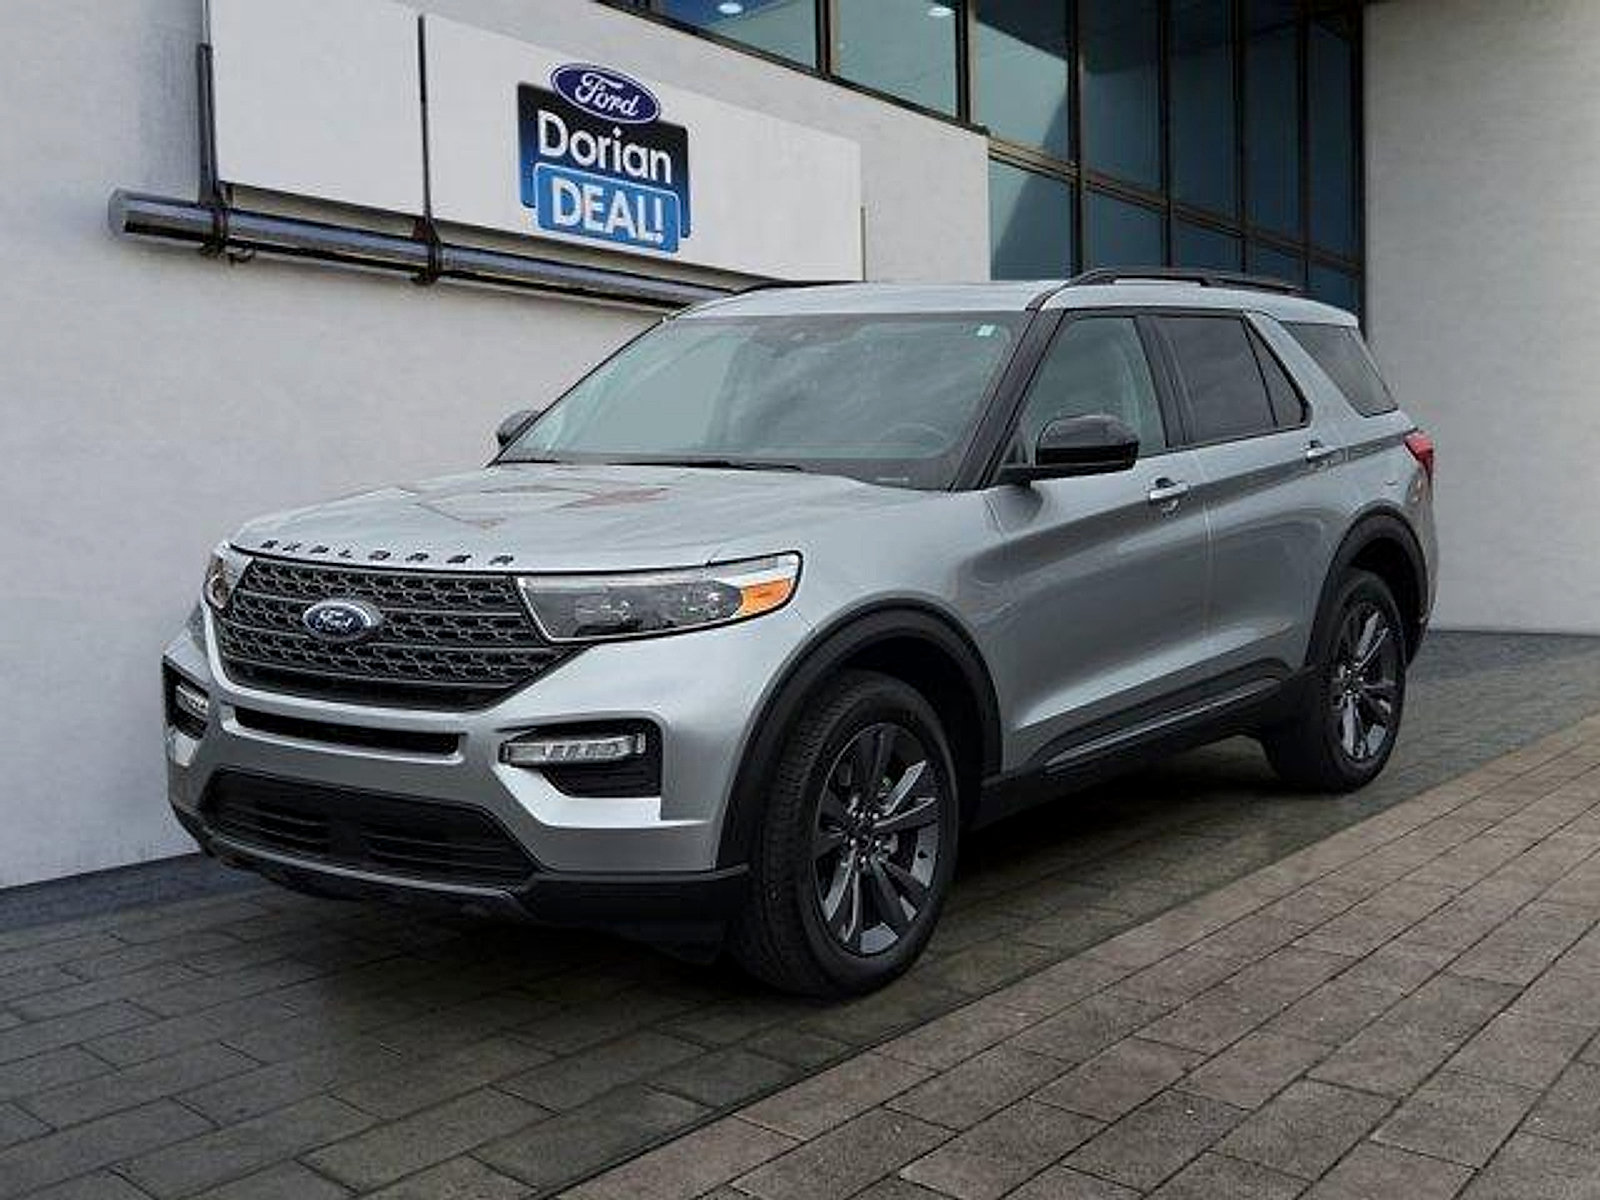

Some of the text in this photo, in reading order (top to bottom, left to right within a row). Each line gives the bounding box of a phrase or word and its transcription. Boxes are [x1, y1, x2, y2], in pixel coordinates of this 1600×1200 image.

[575, 72, 640, 117] Ford
[537, 109, 672, 184] Dorian
[552, 177, 665, 243] DEAL!
